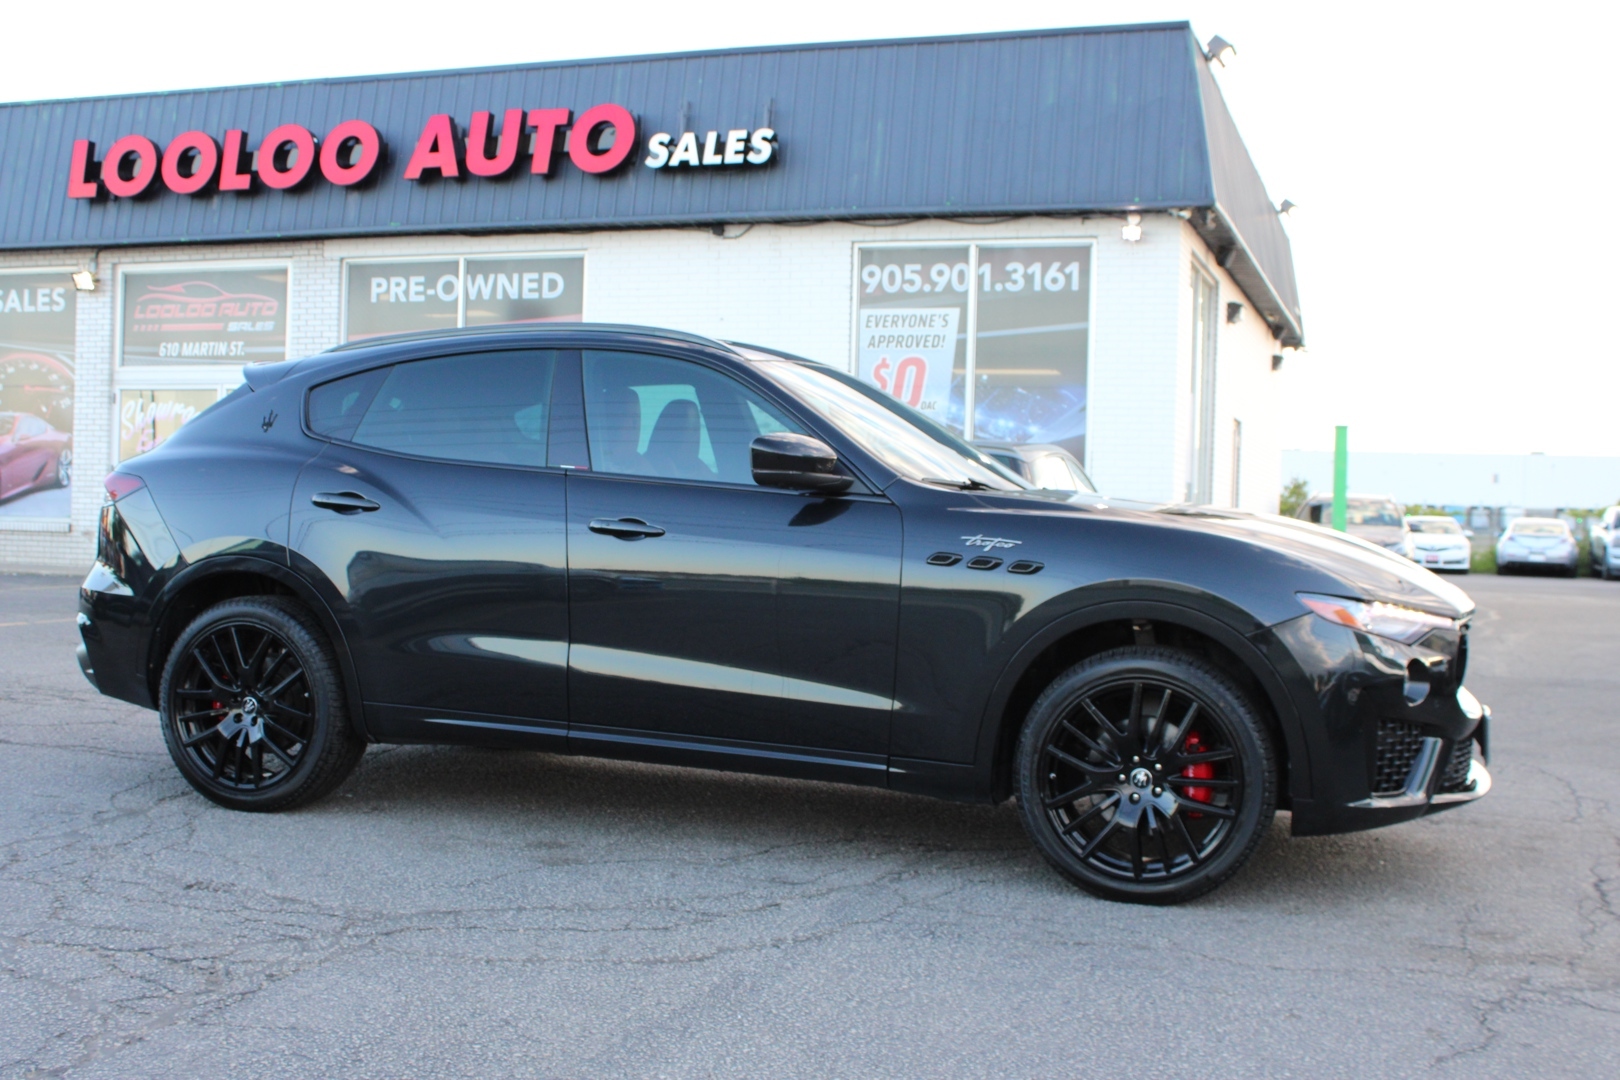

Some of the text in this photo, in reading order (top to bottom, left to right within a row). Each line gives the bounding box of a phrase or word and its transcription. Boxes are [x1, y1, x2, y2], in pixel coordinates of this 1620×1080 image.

[68, 103, 776, 199] LOOLOO AUTO SALES
[370, 271, 565, 303] PRE-OWNED
[861, 261, 1080, 294] 905.901.3161
[0, 286, 67, 313] ALES
[133, 301, 279, 320] LOOLOO AUTO
[227, 320, 276, 332] SALES
[865, 313, 950, 329] EVERYONE'S
[159, 341, 246, 357] 610 MARTIN ST.
[867, 335, 946, 349] APPROVED!
